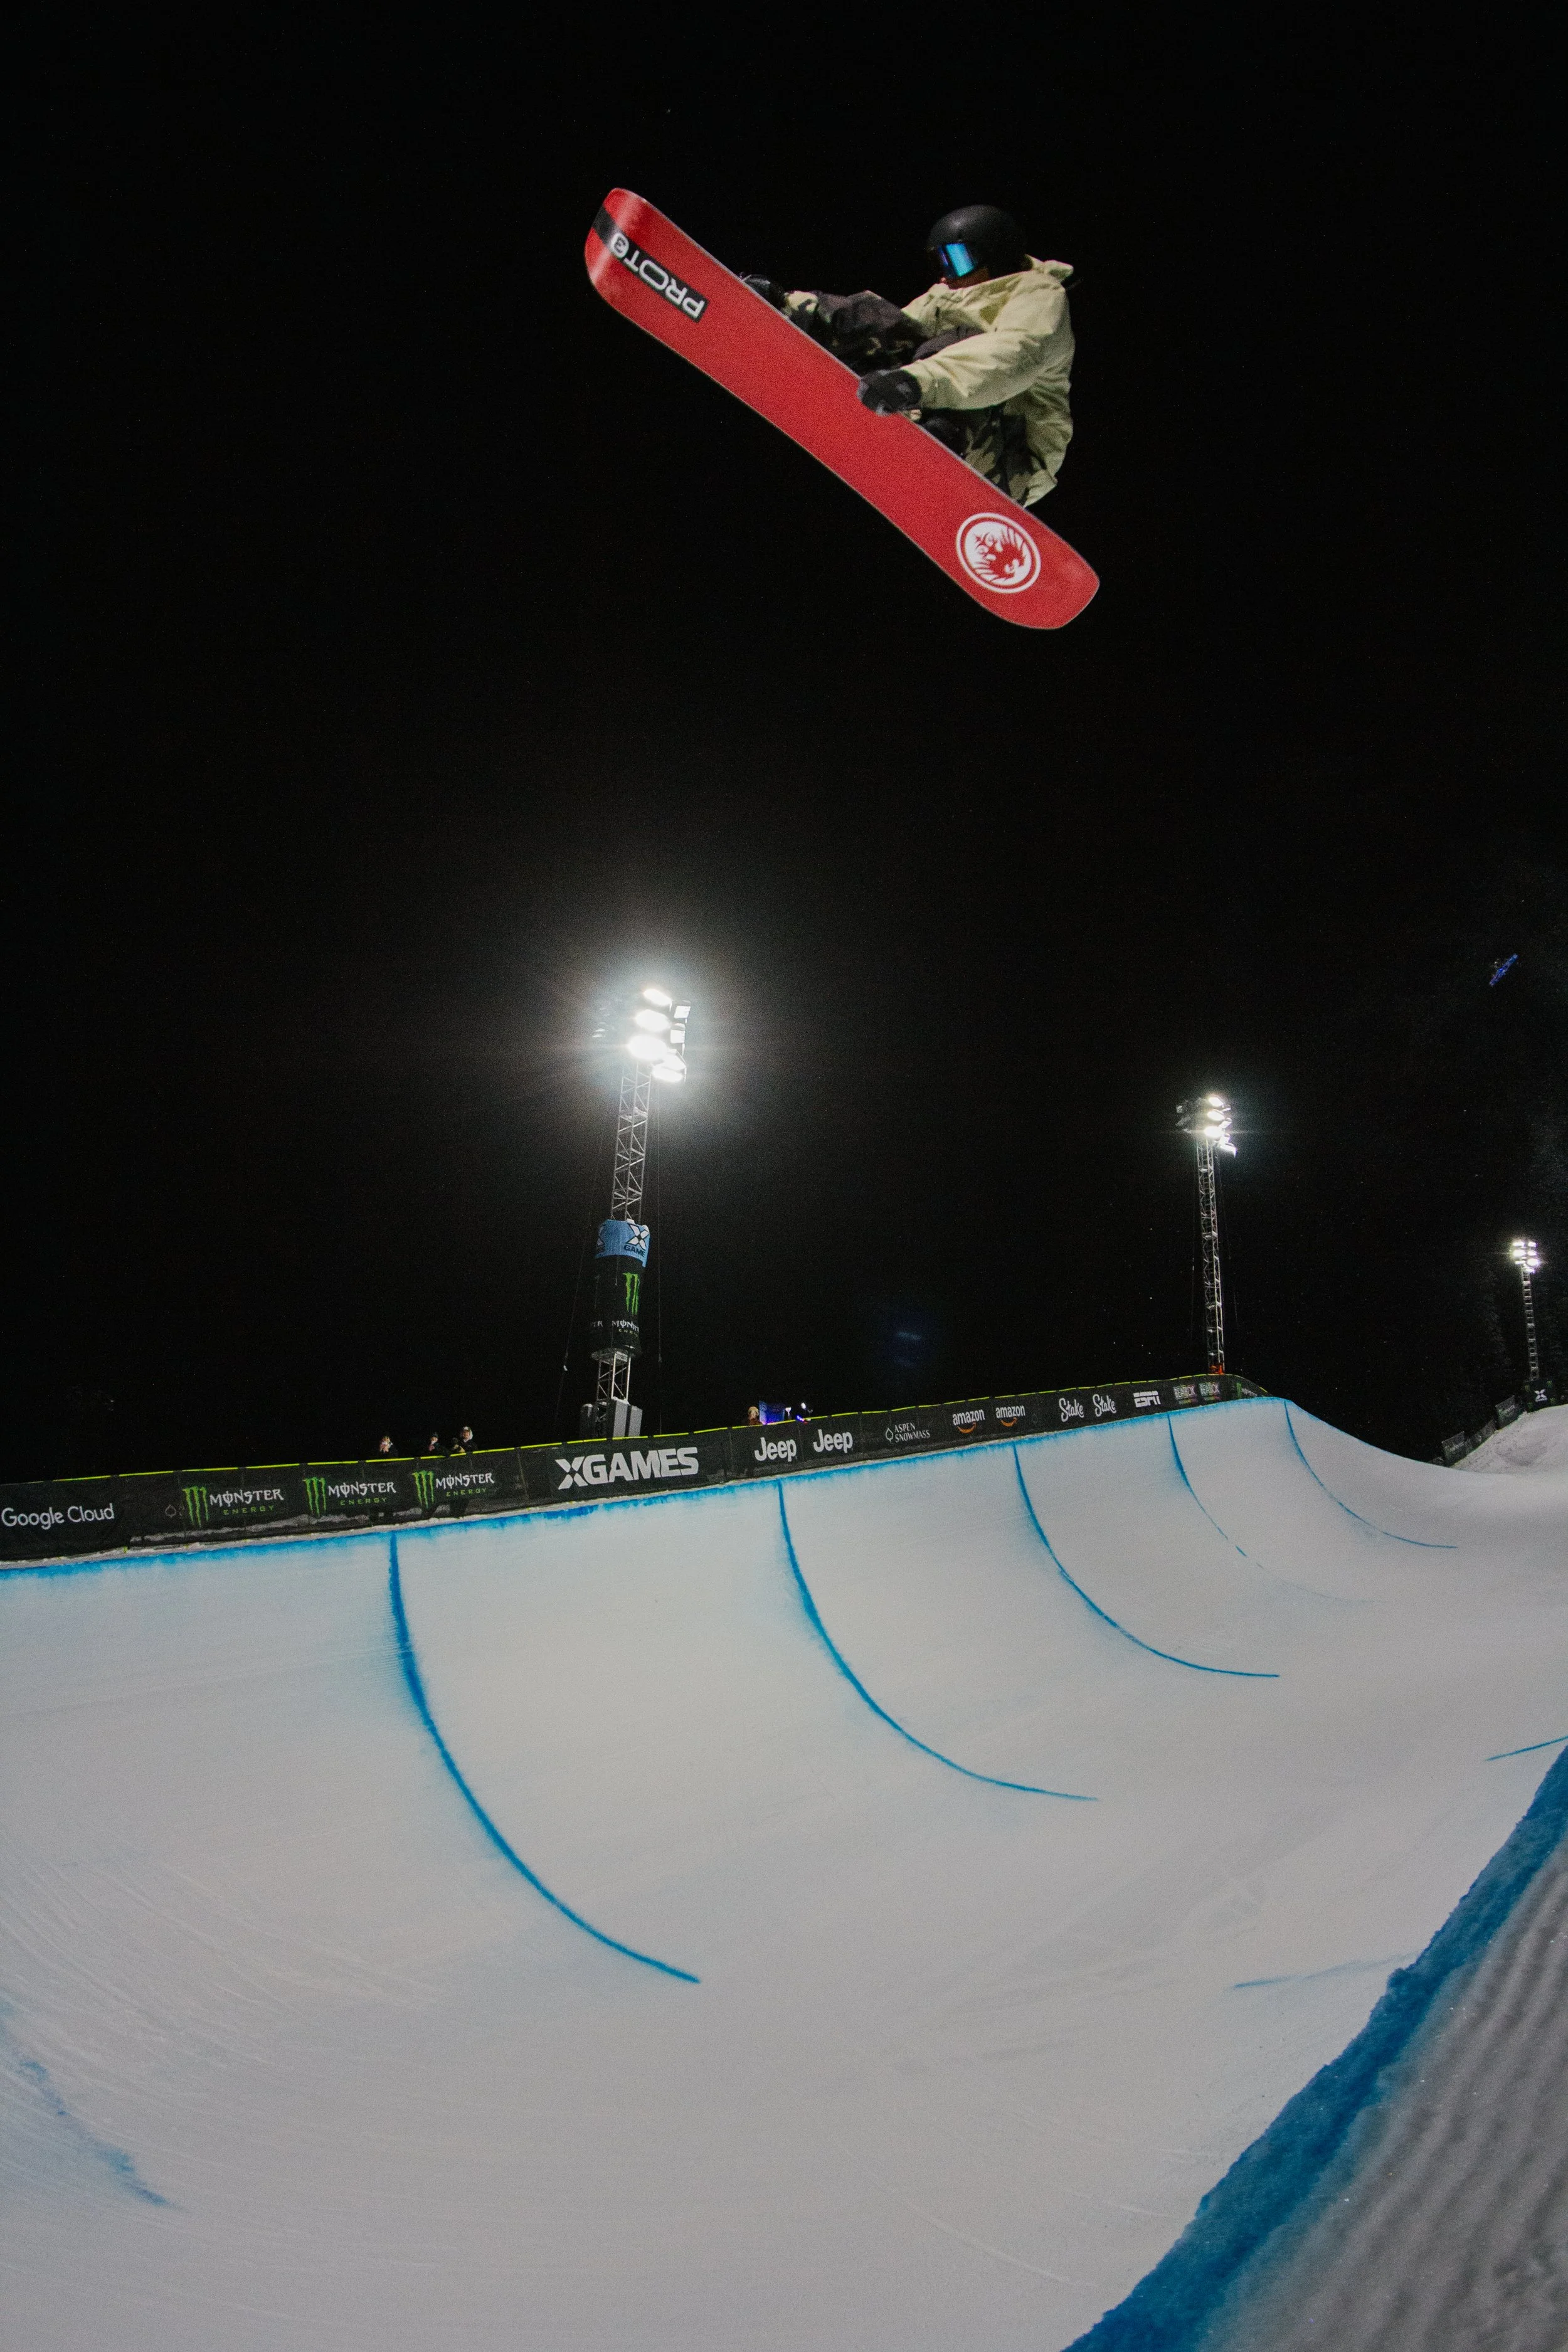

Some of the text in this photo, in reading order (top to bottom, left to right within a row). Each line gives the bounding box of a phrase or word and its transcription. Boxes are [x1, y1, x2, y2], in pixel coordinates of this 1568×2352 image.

[1093, 1394, 1117, 1417] Stake
[1133, 1391, 1161, 1407] ESPN
[953, 1409, 985, 1426] amazon
[995, 1405, 1026, 1419] amazon
[1059, 1397, 1084, 1422] Stake
[894, 1422, 916, 1433] ASPEN
[813, 1429, 854, 1453] Jeep
[894, 1430, 931, 1443] SNOWMASS
[755, 1437, 797, 1462] Jeep
[436, 1473, 495, 1489] MONSTER
[328, 1481, 396, 1498] MONSTER
[446, 1487, 487, 1497] ENERGY
[209, 1489, 284, 1507] MONSTER
[340, 1496, 388, 1506] ENERGY
[1, 1503, 115, 1530] Google Cloud
[222, 1505, 274, 1515] ENERGY
